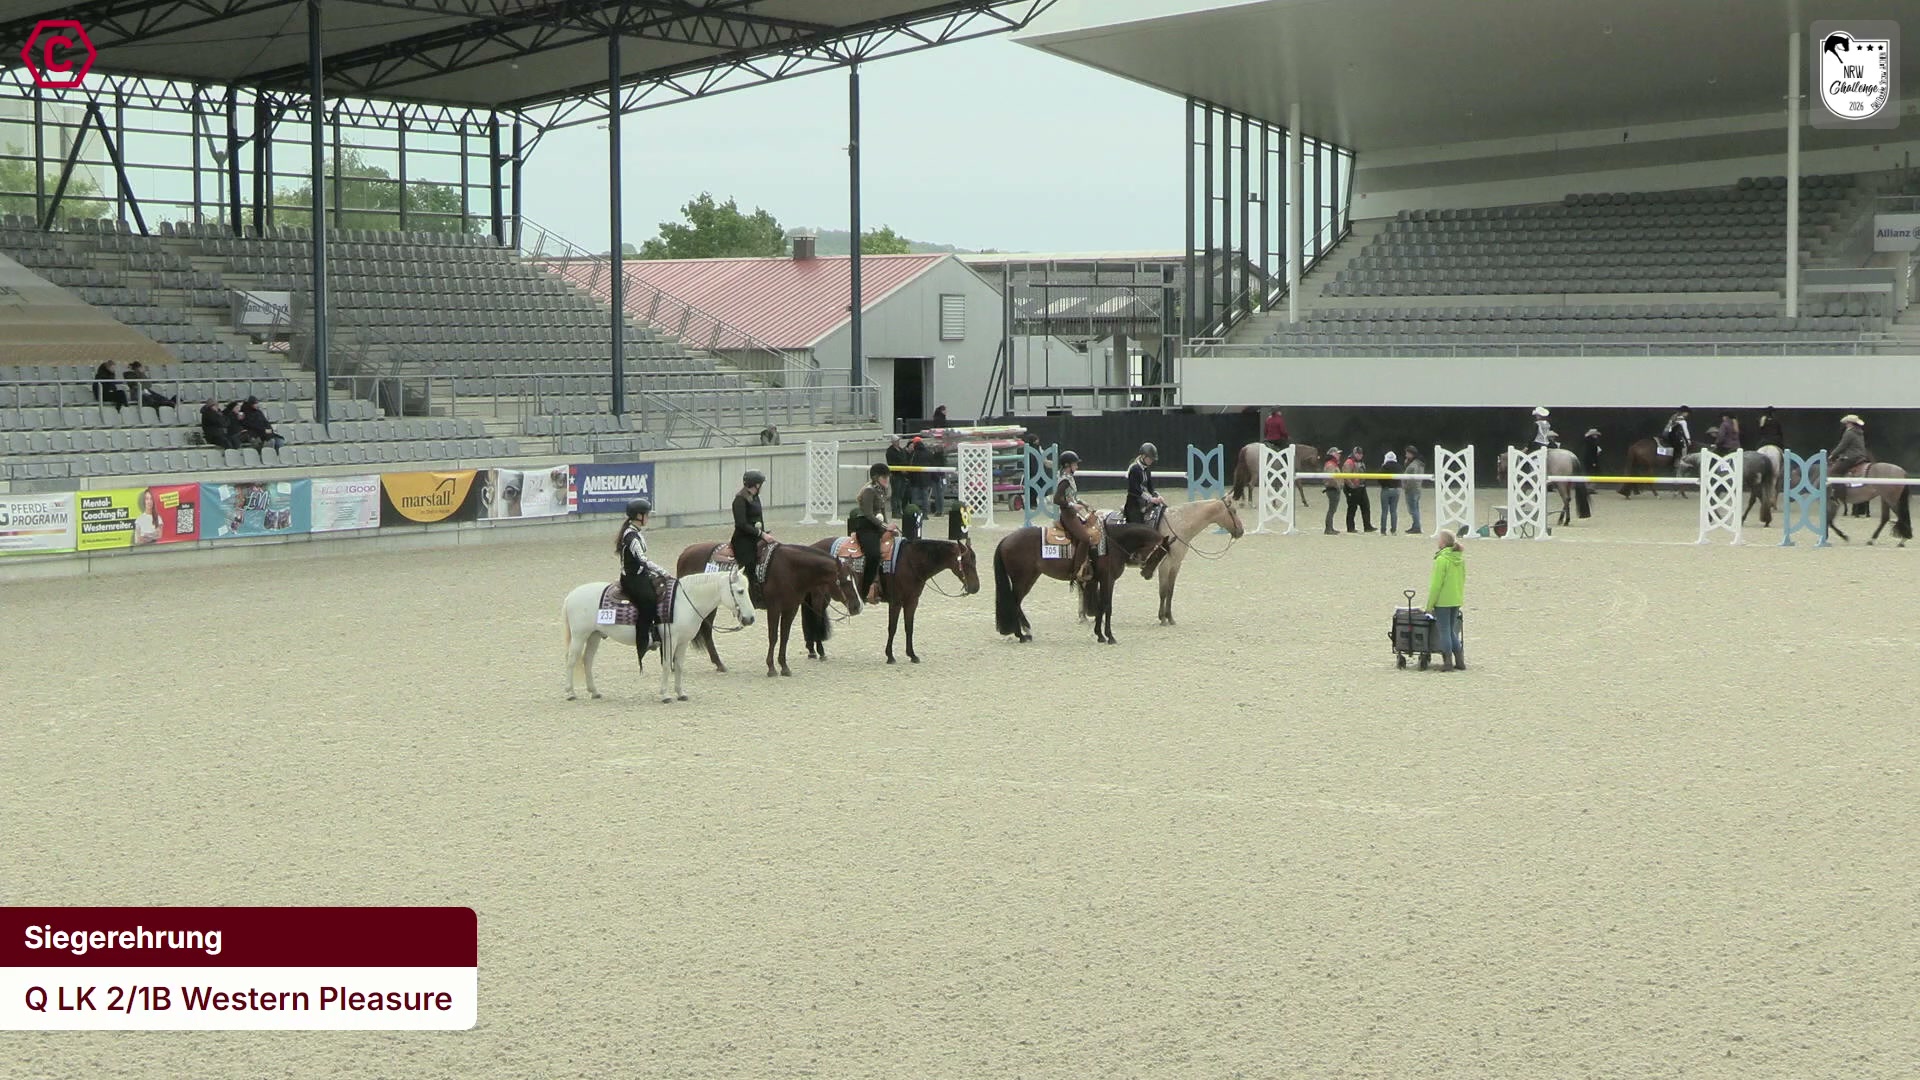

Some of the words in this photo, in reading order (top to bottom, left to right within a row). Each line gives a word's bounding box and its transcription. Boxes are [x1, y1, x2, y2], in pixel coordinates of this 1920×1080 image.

[1876, 228, 1911, 238] Allianz
[948, 357, 955, 366] 13
[583, 475, 648, 495] AMERICANA
[83, 498, 111, 508] Mental-
[401, 490, 451, 508] marstall
[11, 503, 48, 514] PFERDE
[12, 513, 68, 526] PROGRAMM
[83, 510, 116, 520] Coaching
[116, 509, 128, 518] für
[83, 521, 134, 532] Westernreiter.
[1045, 546, 1057, 555] 705
[600, 611, 613, 620] 233
